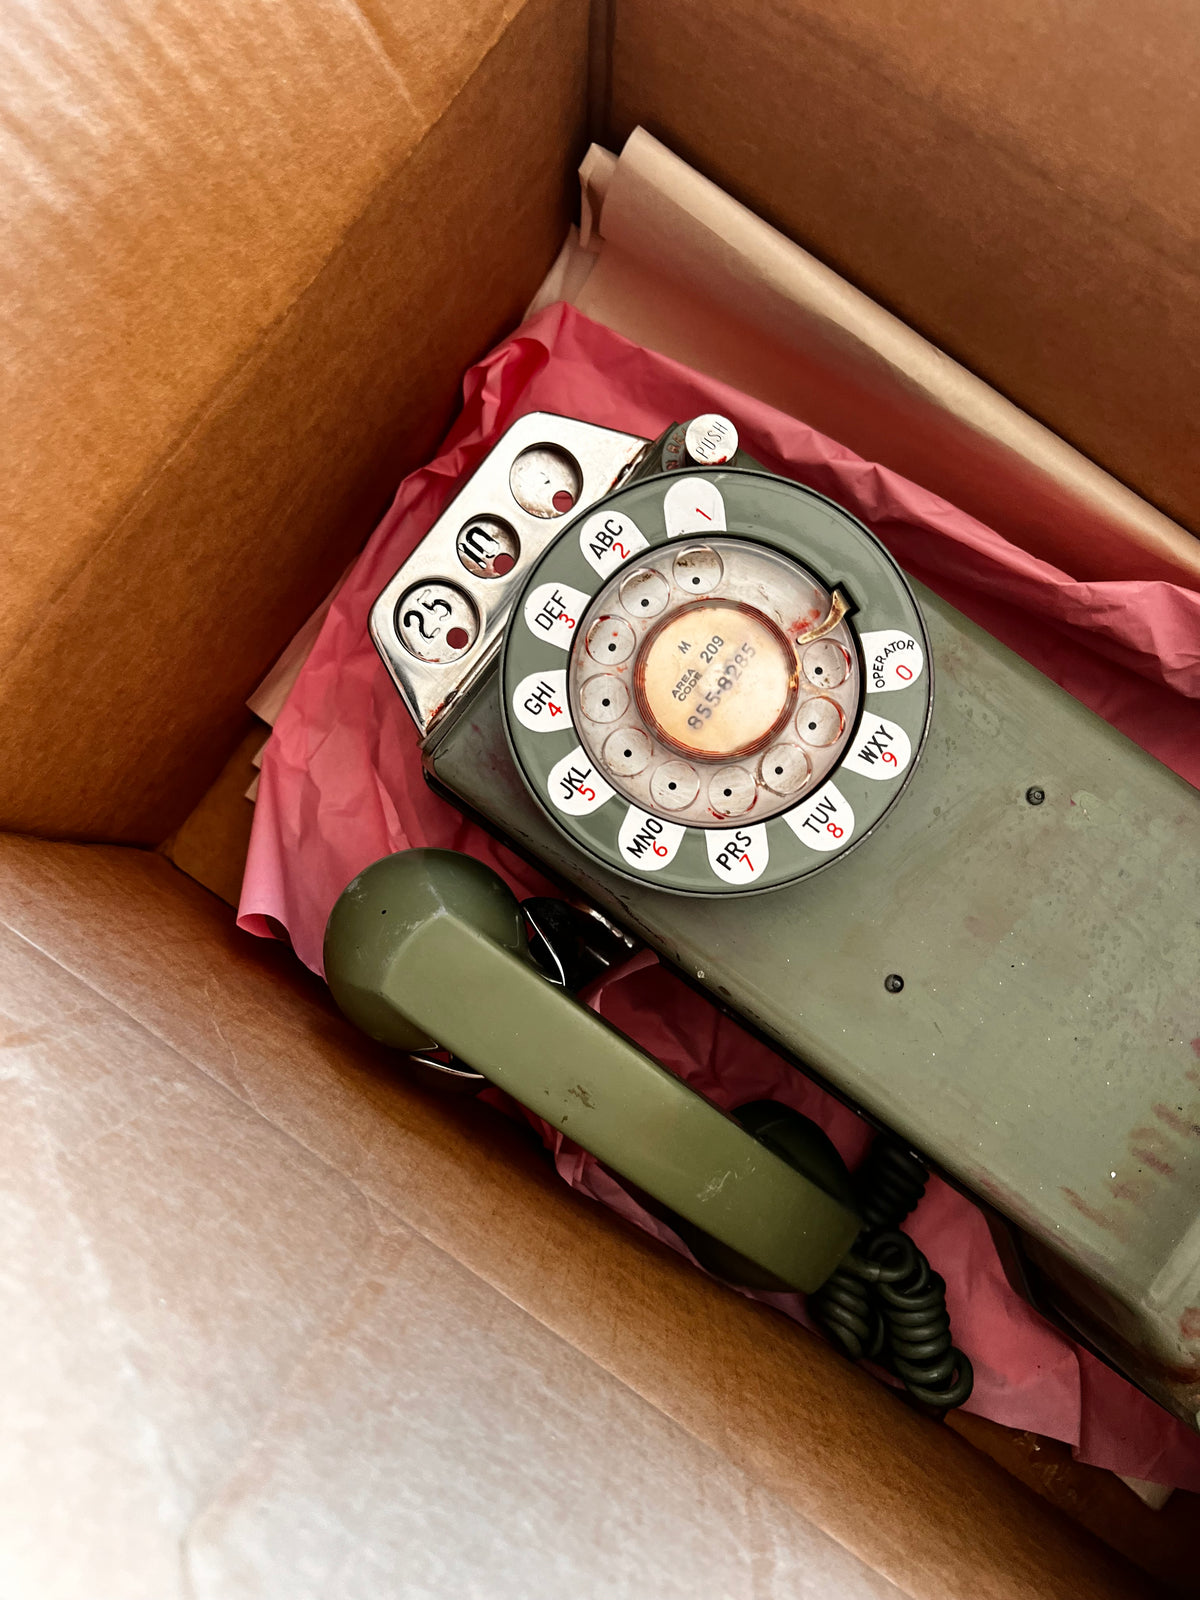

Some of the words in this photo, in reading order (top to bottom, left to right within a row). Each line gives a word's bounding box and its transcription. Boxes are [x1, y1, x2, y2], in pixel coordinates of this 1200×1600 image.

[695, 421, 728, 460] PUSH
[695, 507, 712, 521] 1
[589, 519, 623, 560] ABC
[612, 542, 631, 559] 2
[403, 588, 453, 644] 25
[534, 590, 566, 631] DEF
[558, 613, 576, 629] 3
[677, 640, 692, 654] M
[700, 635, 725, 664] 209
[872, 640, 915, 688] OPERATOR
[895, 664, 913, 681] 0
[524, 681, 556, 716] GHI
[671, 668, 696, 699] AREA
[677, 671, 703, 702] CODE
[687, 642, 756, 730] 855-8285
[547, 701, 563, 717] 4
[857, 724, 894, 765] WXY
[881, 751, 898, 768] 9
[559, 767, 592, 800] JKL
[577, 784, 596, 801] 5
[802, 796, 838, 834] TUV
[826, 822, 844, 839] 8
[626, 818, 664, 859] MNO
[653, 840, 668, 857] 6
[716, 831, 752, 871] PRS
[739, 854, 754, 872] 7
